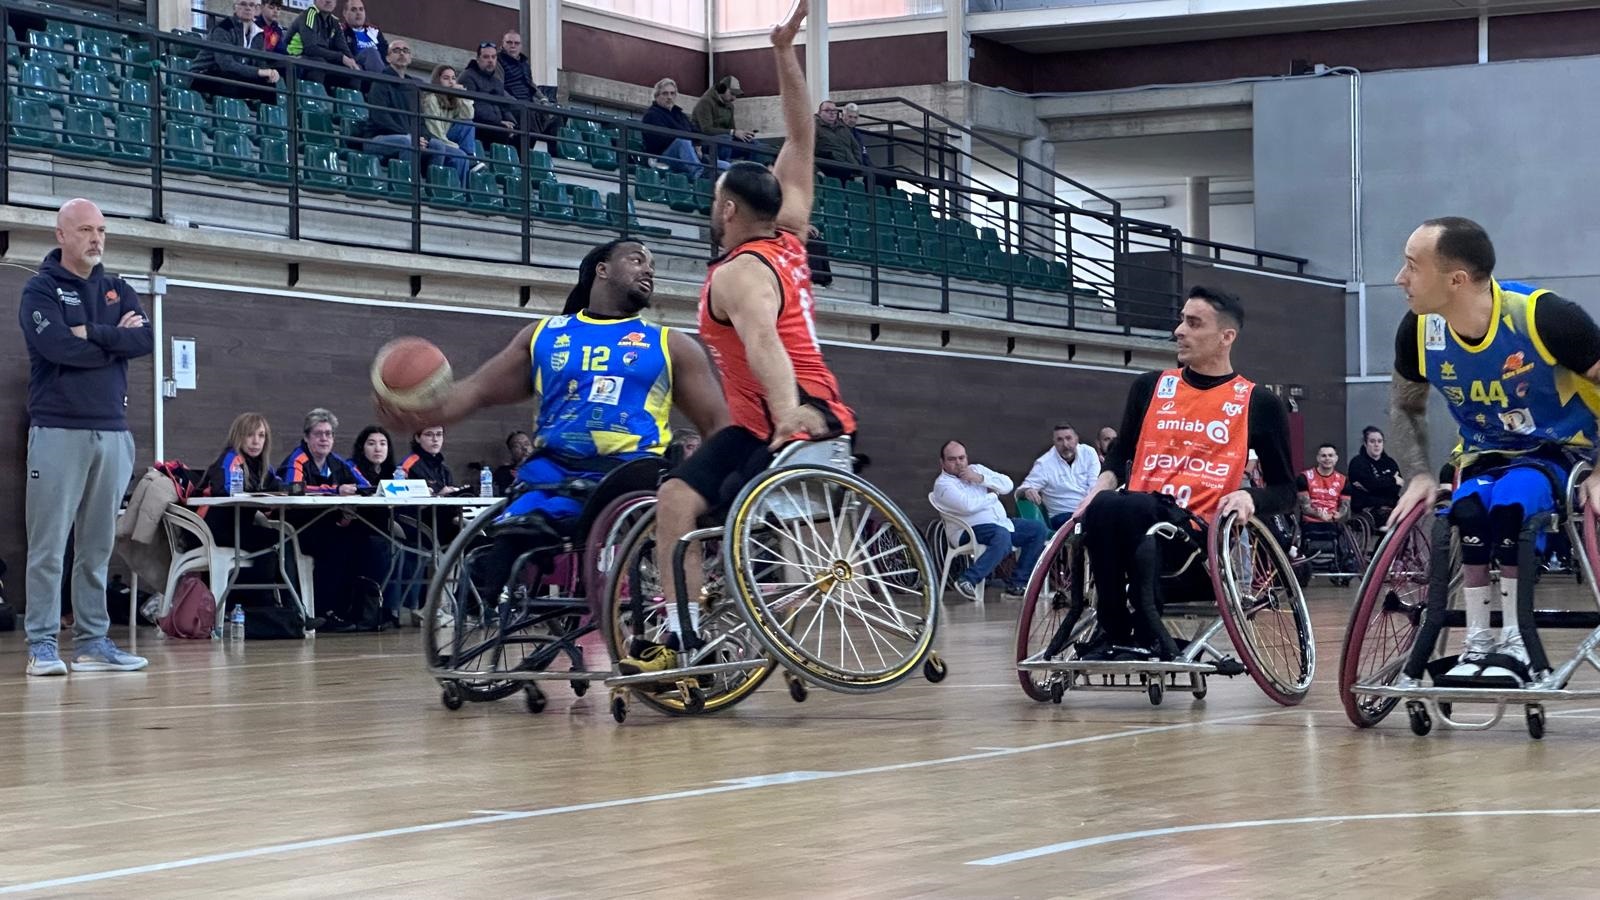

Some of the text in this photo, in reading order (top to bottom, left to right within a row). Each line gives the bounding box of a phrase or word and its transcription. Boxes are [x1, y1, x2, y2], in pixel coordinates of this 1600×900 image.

[581, 345, 611, 371] 12
[1470, 380, 1509, 408] 44
[1156, 417, 1205, 433] amiab
[1143, 453, 1230, 476] gaviota
